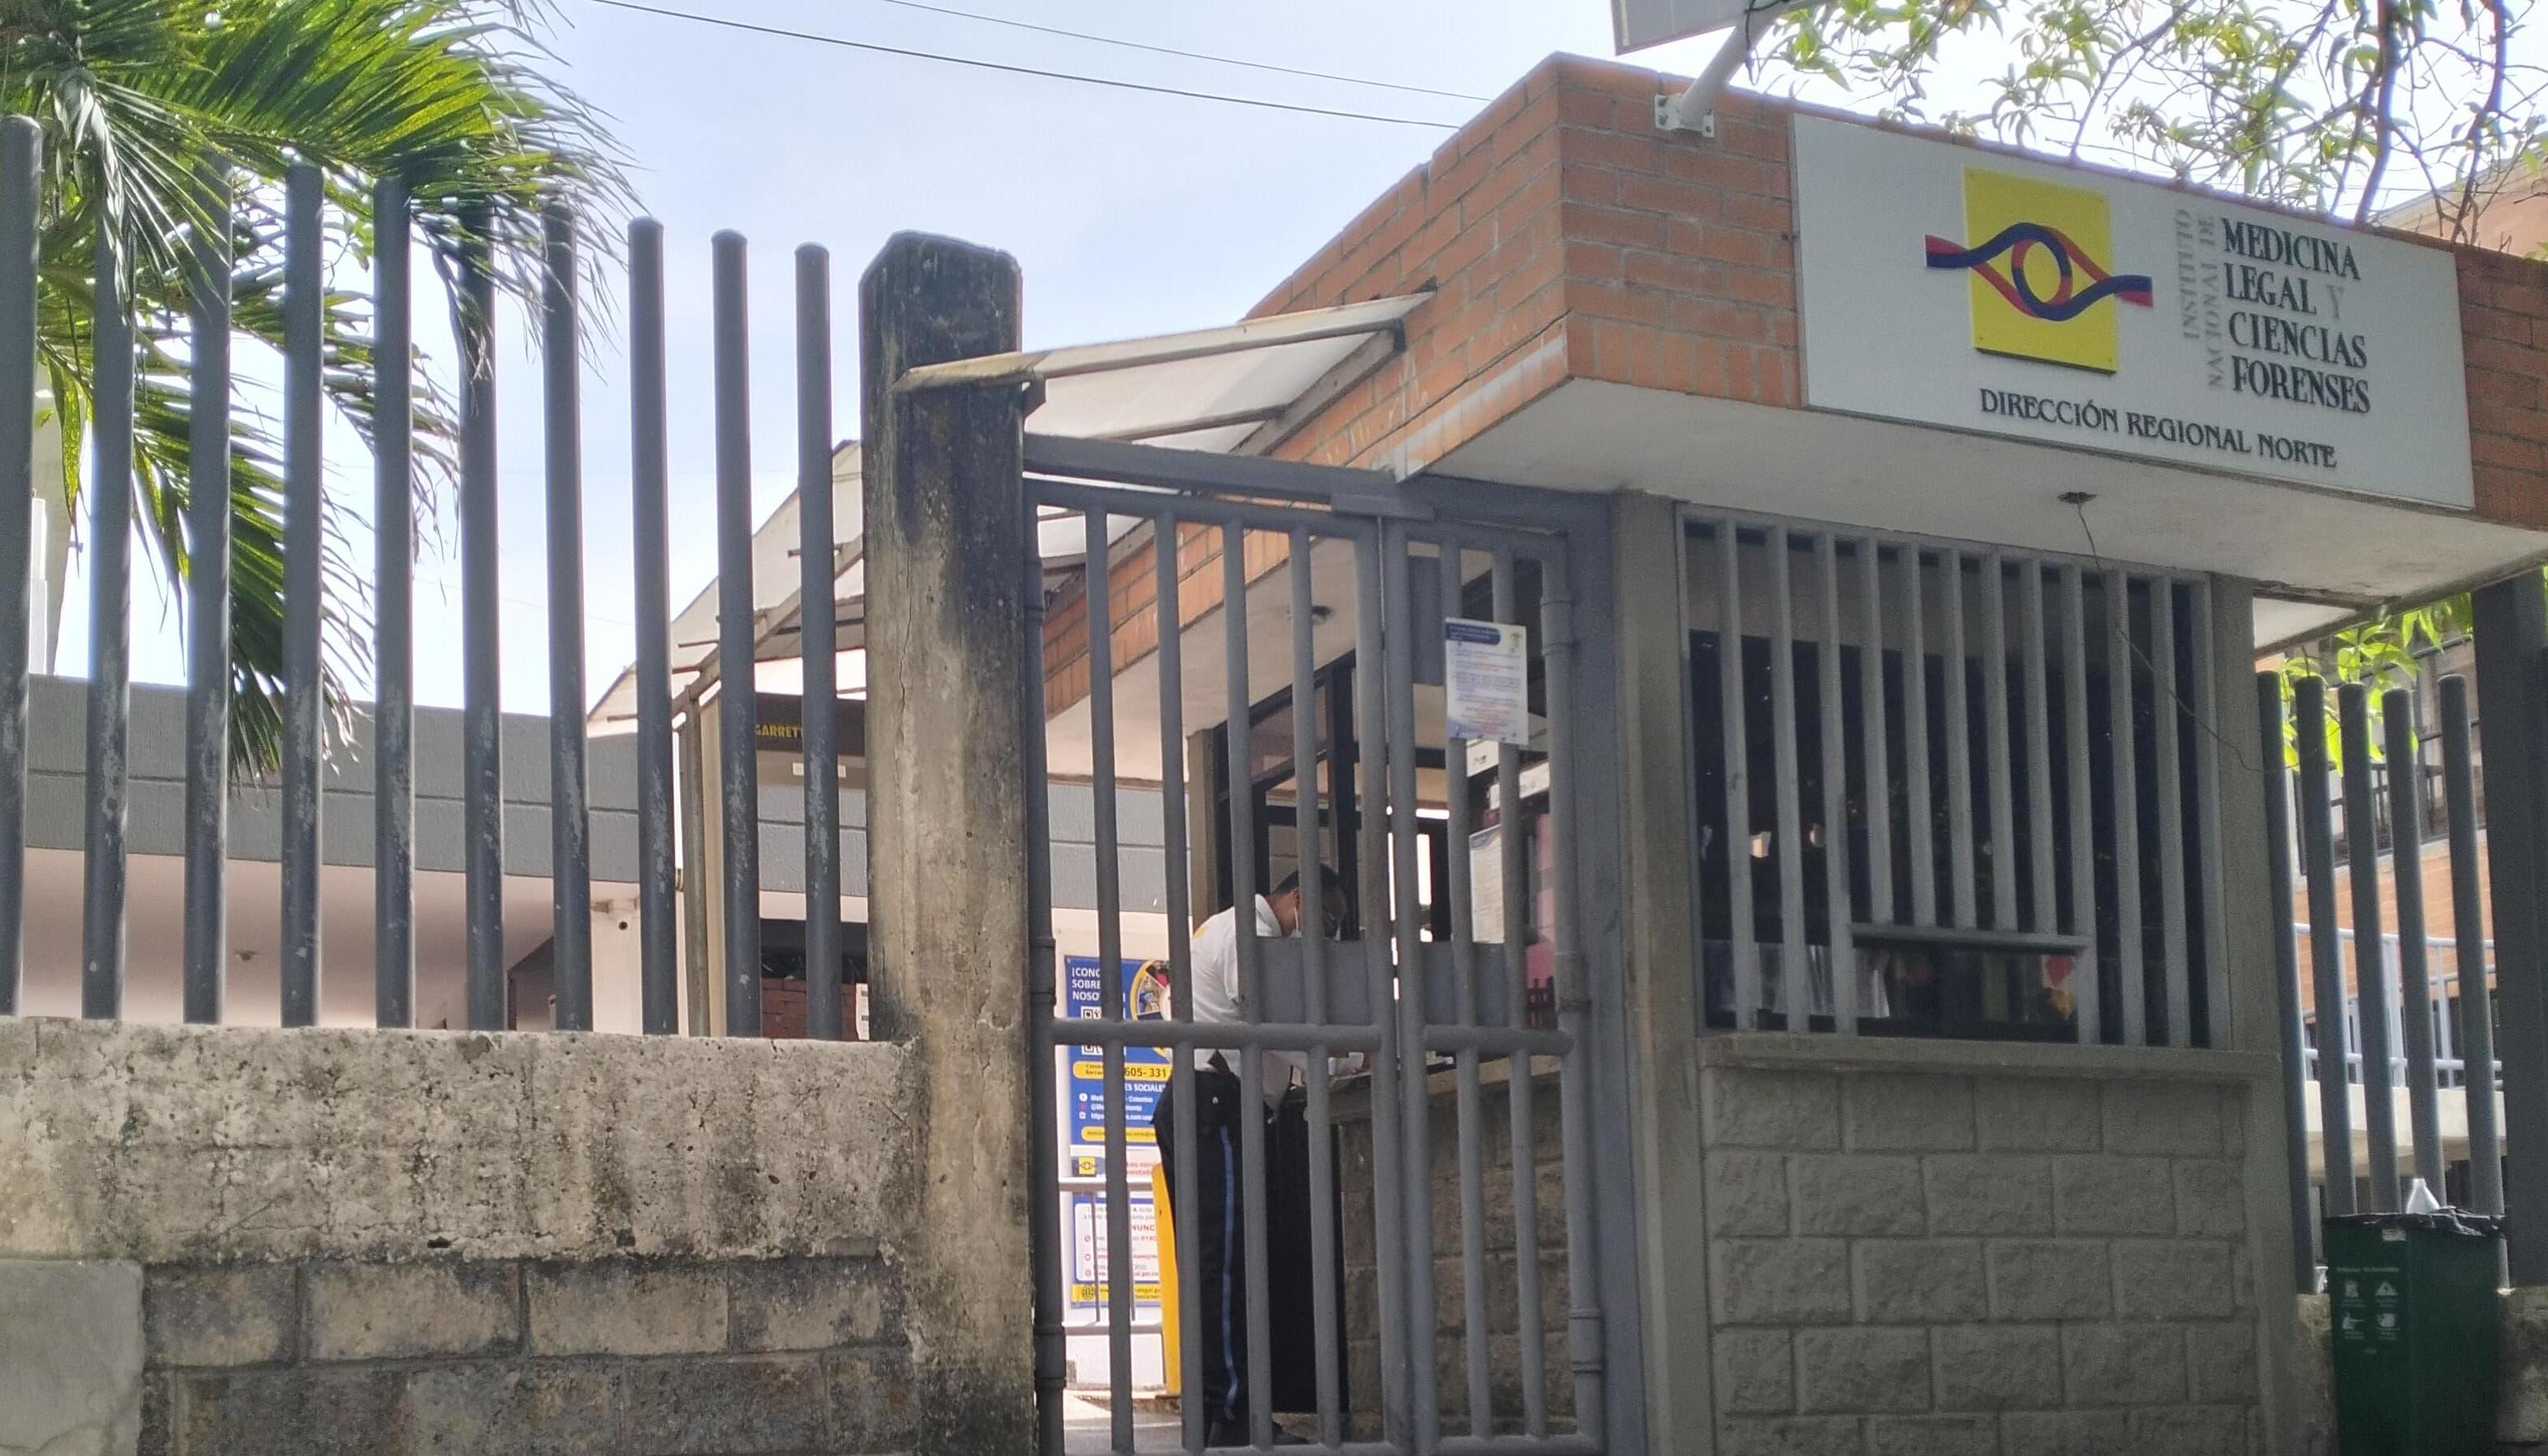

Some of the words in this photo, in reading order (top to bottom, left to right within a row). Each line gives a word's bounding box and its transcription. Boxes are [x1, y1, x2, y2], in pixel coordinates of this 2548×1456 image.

[2197, 215, 2216, 245] DE
[2220, 216, 2362, 281] MEDICINA
[2223, 262, 2318, 316] LEGAL
[2325, 283, 2345, 321] Y
[2200, 261, 2226, 388] NACIONAL
[2228, 311, 2368, 369] CIENCIAS
[2231, 355, 2371, 414] FORENSES
[1979, 388, 2119, 433] DIRECCIÓN
[2126, 411, 2252, 454] REGIONAL
[2257, 433, 2338, 468] NORTE
[1134, 1083, 1165, 1093] SOCIALE
